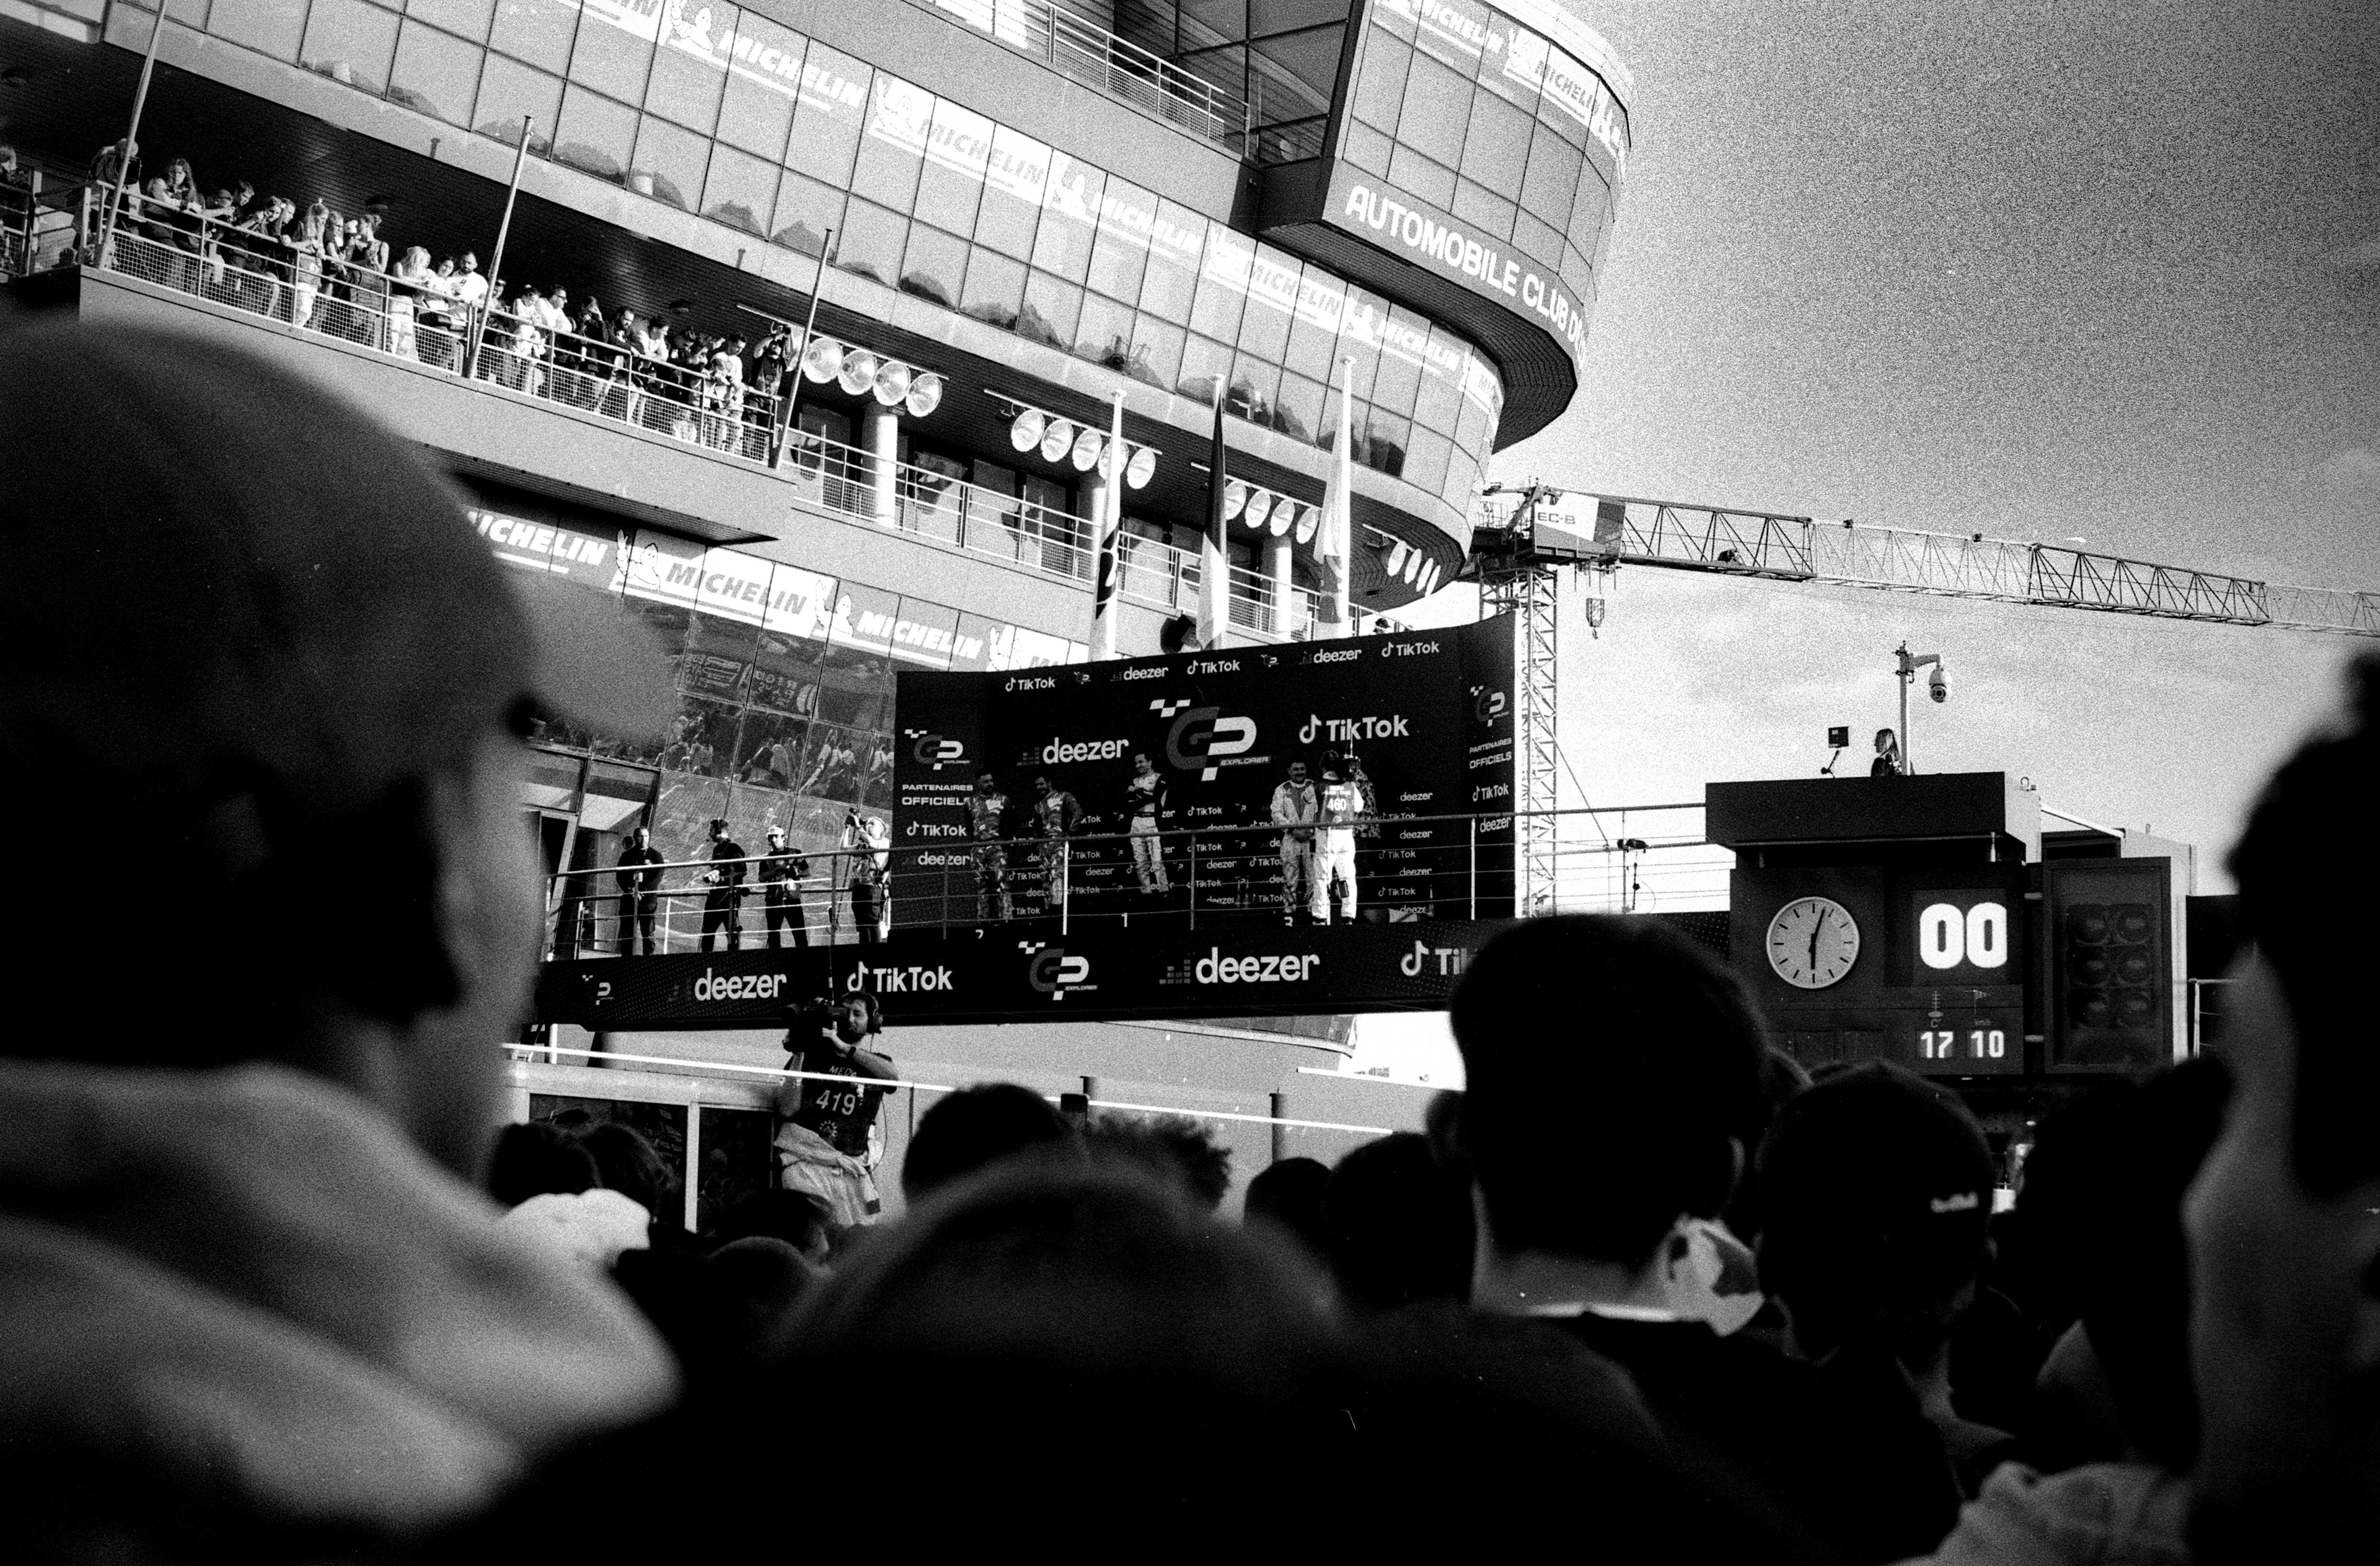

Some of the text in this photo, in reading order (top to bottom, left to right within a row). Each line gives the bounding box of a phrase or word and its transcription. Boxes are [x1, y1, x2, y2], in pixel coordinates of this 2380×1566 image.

[1415, 0, 1504, 54] MICHELIN
[717, 30, 866, 108] MICHELIN
[1534, 59, 1600, 117] MICHELIN
[917, 118, 1044, 185] MICHELIN
[1090, 191, 1203, 255] MICHELIN
[1344, 185, 1520, 297] AUTOMOBILE
[1522, 273, 1569, 332] CLUB
[1242, 260, 1342, 315] MICHELIN
[1376, 319, 1460, 372] MICHELIN
[665, 562, 808, 615] MICHELIN
[856, 610, 984, 659] MICHELIN
[1313, 648, 1362, 664] deezer
[1396, 641, 1440, 657] TikTok
[1123, 666, 1169, 681] deezer
[1201, 659, 1240, 674] TikTok
[1018, 677, 1056, 691] TikTok
[1326, 715, 1409, 742] TikTok
[1042, 736, 1130, 765] deezer
[1469, 737, 1512, 754] PARTENAIRES
[1220, 755, 1269, 766] EXPLORER
[1469, 751, 1512, 769] OFFICIELS
[1400, 791, 1434, 802] deezer
[1481, 783, 1509, 800] TikTok
[1196, 806, 1223, 816] TikTok
[1327, 798, 1347, 811] 460
[1161, 810, 1176, 818] zer
[921, 824, 967, 837] TikTok
[1480, 817, 1512, 834] deezer
[1399, 830, 1433, 840] deezer
[1075, 850, 1101, 860] TikTok
[1196, 843, 1223, 852] TikTok
[1388, 850, 1416, 859] TikTok
[917, 851, 971, 866] deezer
[1206, 859, 1237, 869] deezer
[1258, 857, 1282, 866] TikTo
[1085, 866, 1115, 876] deezer
[1399, 867, 1432, 877] deezer
[1075, 886, 1101, 894] TikTok
[1195, 878, 1222, 888] TikTok
[1388, 887, 1416, 897] TikTok
[1016, 907, 1041, 915] TikTok
[1400, 904, 1427, 914] deeze
[1121, 912, 1128, 928] 1
[1919, 902, 2008, 970] 00
[1195, 946, 1321, 984] deezer
[694, 967, 788, 1001] deezer
[873, 966, 953, 993] TikTok
[1920, 1031, 1954, 1058] 17
[1970, 1030, 2005, 1058] 10
[816, 1089, 856, 1115] 419
